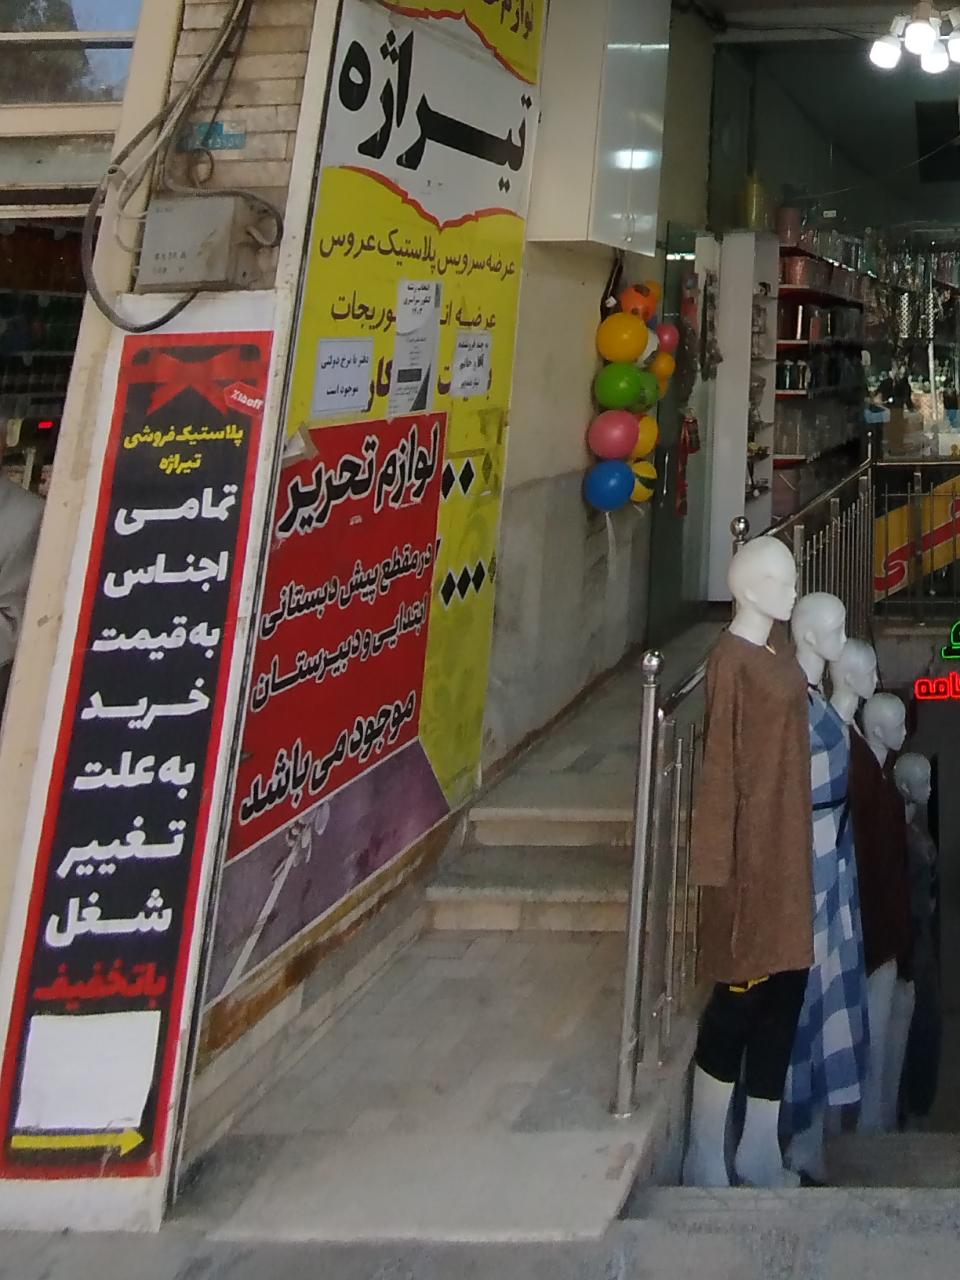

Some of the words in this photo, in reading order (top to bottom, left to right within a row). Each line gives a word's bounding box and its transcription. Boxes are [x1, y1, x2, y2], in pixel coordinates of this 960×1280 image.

[338, 29, 533, 192] تیراژه
[320, 230, 375, 259] عروس
[378, 230, 437, 272] پلاستیک
[437, 251, 486, 275] سرویس
[487, 255, 515, 280] عرضه
[330, 292, 397, 332] وریجات
[455, 308, 496, 329] عرضه
[123, 426, 176, 449] فروشی
[177, 424, 244, 447] پلاستیک
[159, 452, 202, 475] تیراژه
[374, 421, 440, 514] لوازم
[275, 434, 377, 538] تحریر
[114, 484, 238, 535] تمامی
[103, 551, 229, 598] اجناس
[379, 545, 419, 594] مقطع
[260, 577, 339, 639] دبستانی
[91, 616, 188, 660] قیمت
[189, 622, 221, 658] به
[251, 630, 361, 712] دبیرستان
[80, 678, 210, 730] خرید
[350, 690, 416, 762] موجود
[73, 751, 155, 790] علت
[158, 756, 195, 799] به
[56, 816, 187, 879] تغییر
[45, 888, 173, 947] شغل
